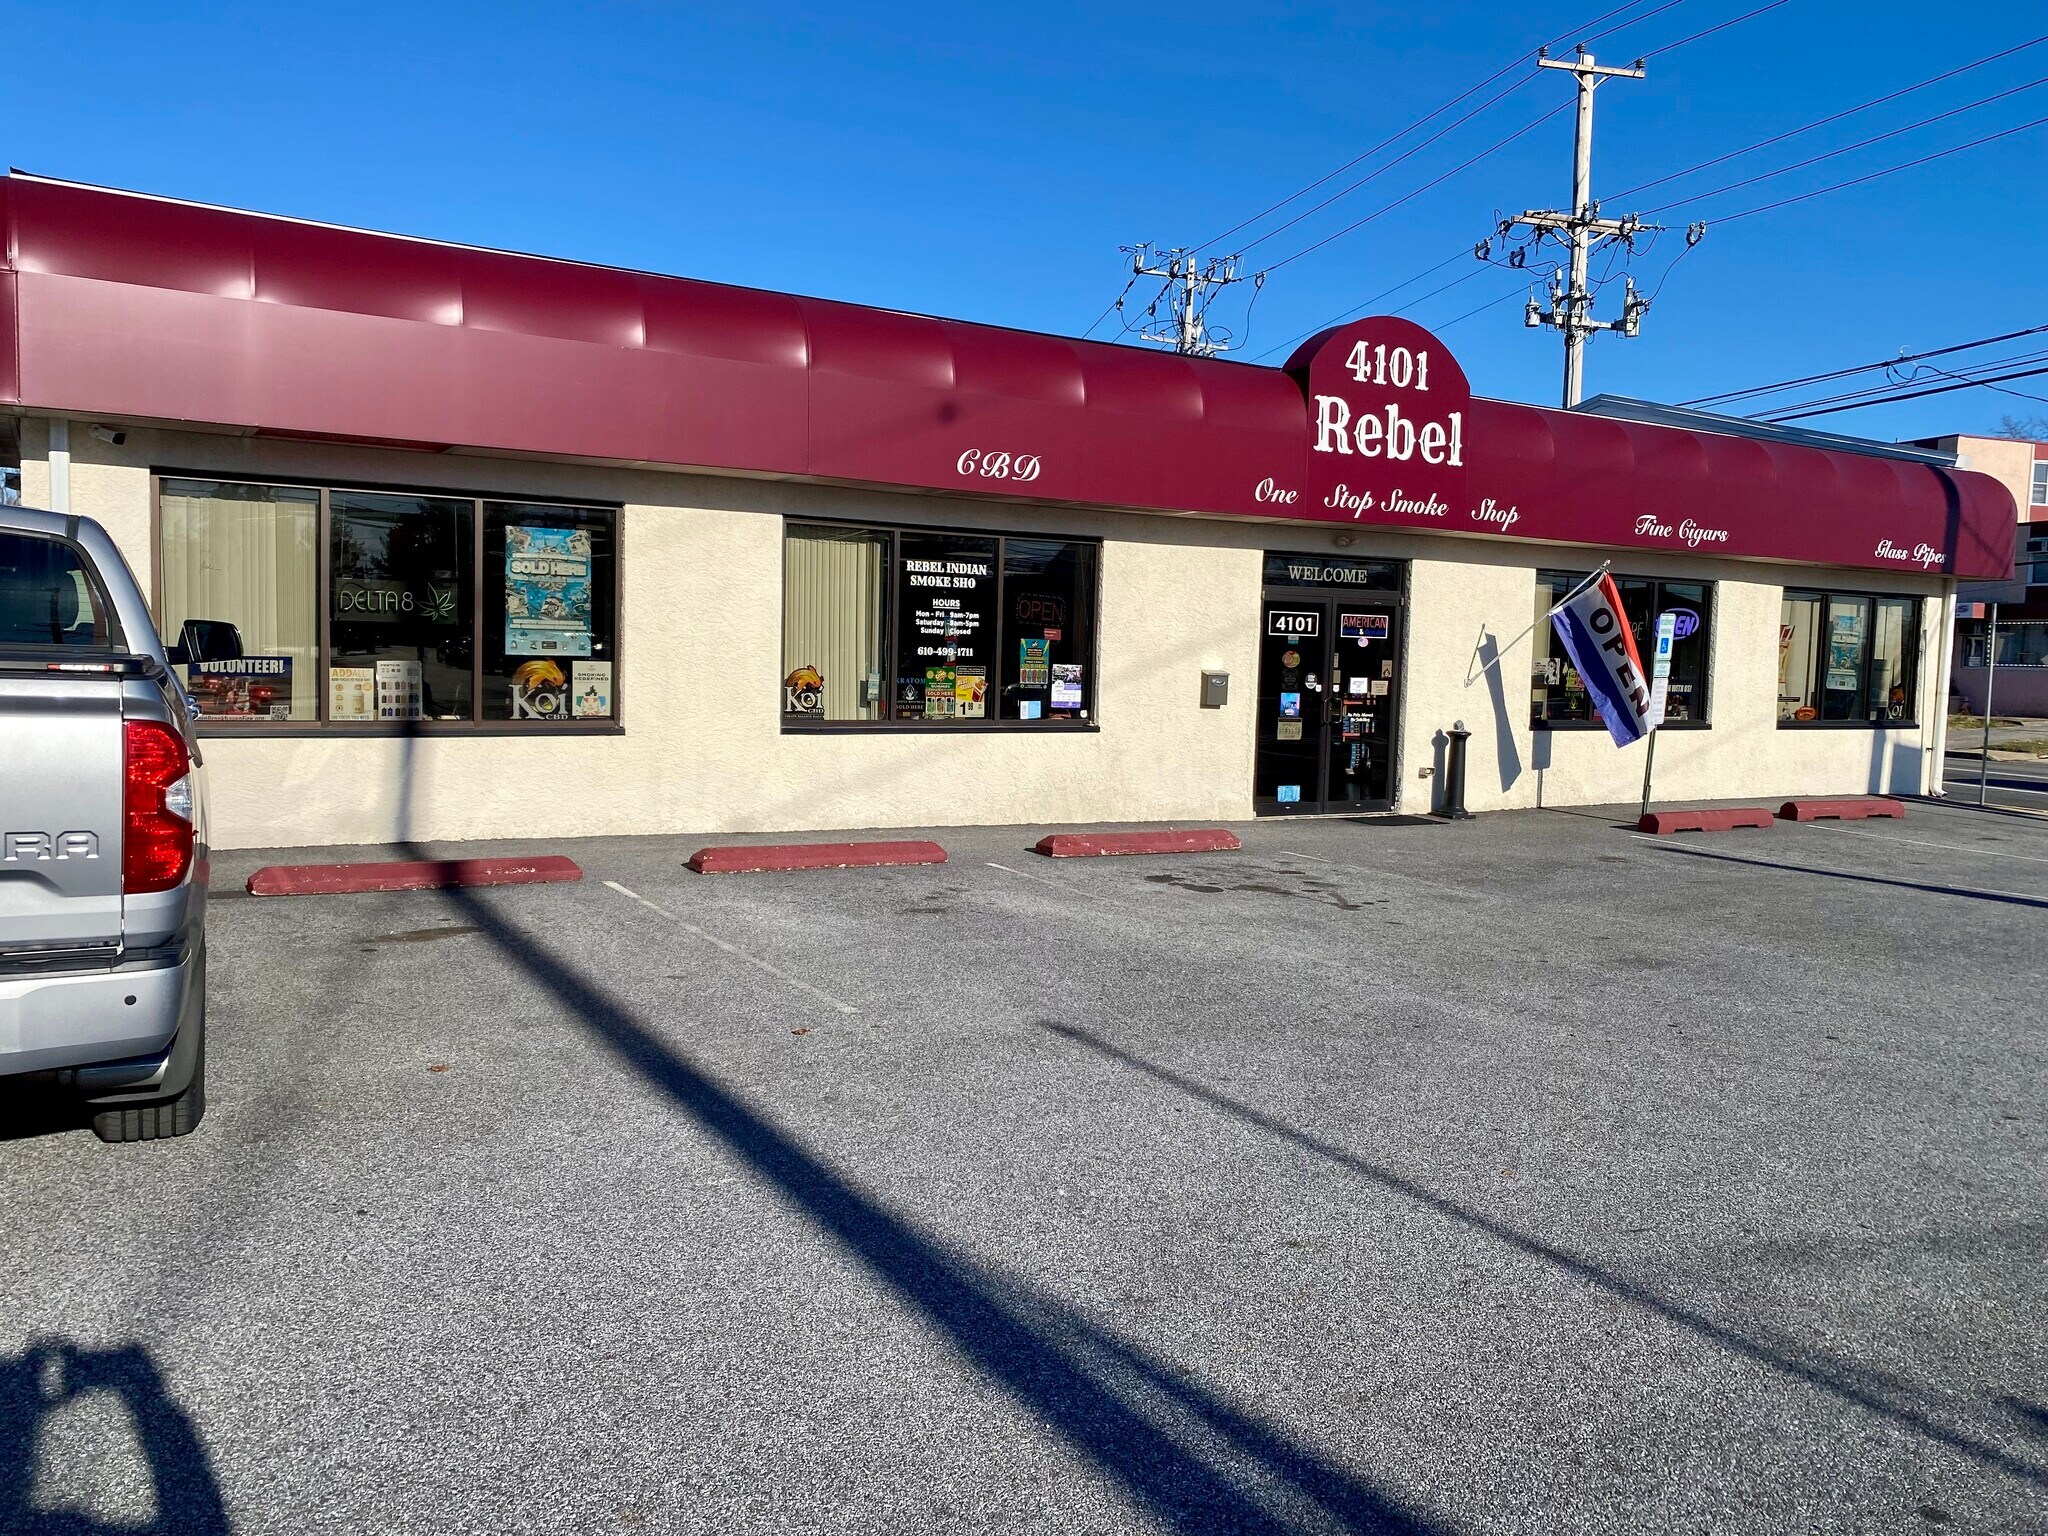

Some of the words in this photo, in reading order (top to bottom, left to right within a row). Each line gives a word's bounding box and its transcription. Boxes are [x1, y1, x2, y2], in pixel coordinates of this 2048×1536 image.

[1345, 340, 1429, 391] 4101
[1313, 395, 1463, 467] Rebel
[1255, 478, 1299, 504] One
[1324, 484, 1376, 518] Stop
[1381, 489, 1449, 517] Smoke
[1471, 499, 1521, 532] Shop
[1635, 515, 1674, 538] Fine
[1679, 519, 1729, 548] Cigars
[1875, 538, 1909, 560] Glass
[1911, 543, 1947, 569] Pipes
[511, 560, 549, 575] SOLD
[550, 562, 587, 576] HERE
[906, 560, 945, 573] REBEL
[946, 562, 987, 575] INDIAN
[1288, 565, 1367, 583] WELCOME
[910, 575, 951, 588] SMOKE
[952, 577, 976, 589] SHO
[340, 590, 398, 611] DELTA
[401, 591, 414, 611] 8
[932, 598, 960, 608] HOURS
[915, 610, 930, 618] Mon
[949, 611, 980, 620] 9am-7pm
[1019, 599, 1063, 621] OPEN
[1275, 616, 1312, 631] 4101
[1343, 616, 1387, 628] AMERICAN
[920, 627, 945, 635] Sunday
[917, 646, 974, 657] 610-499-1711
[200, 659, 285, 673] VOLUNTEER!
[1590, 607, 1650, 717] OPEN
